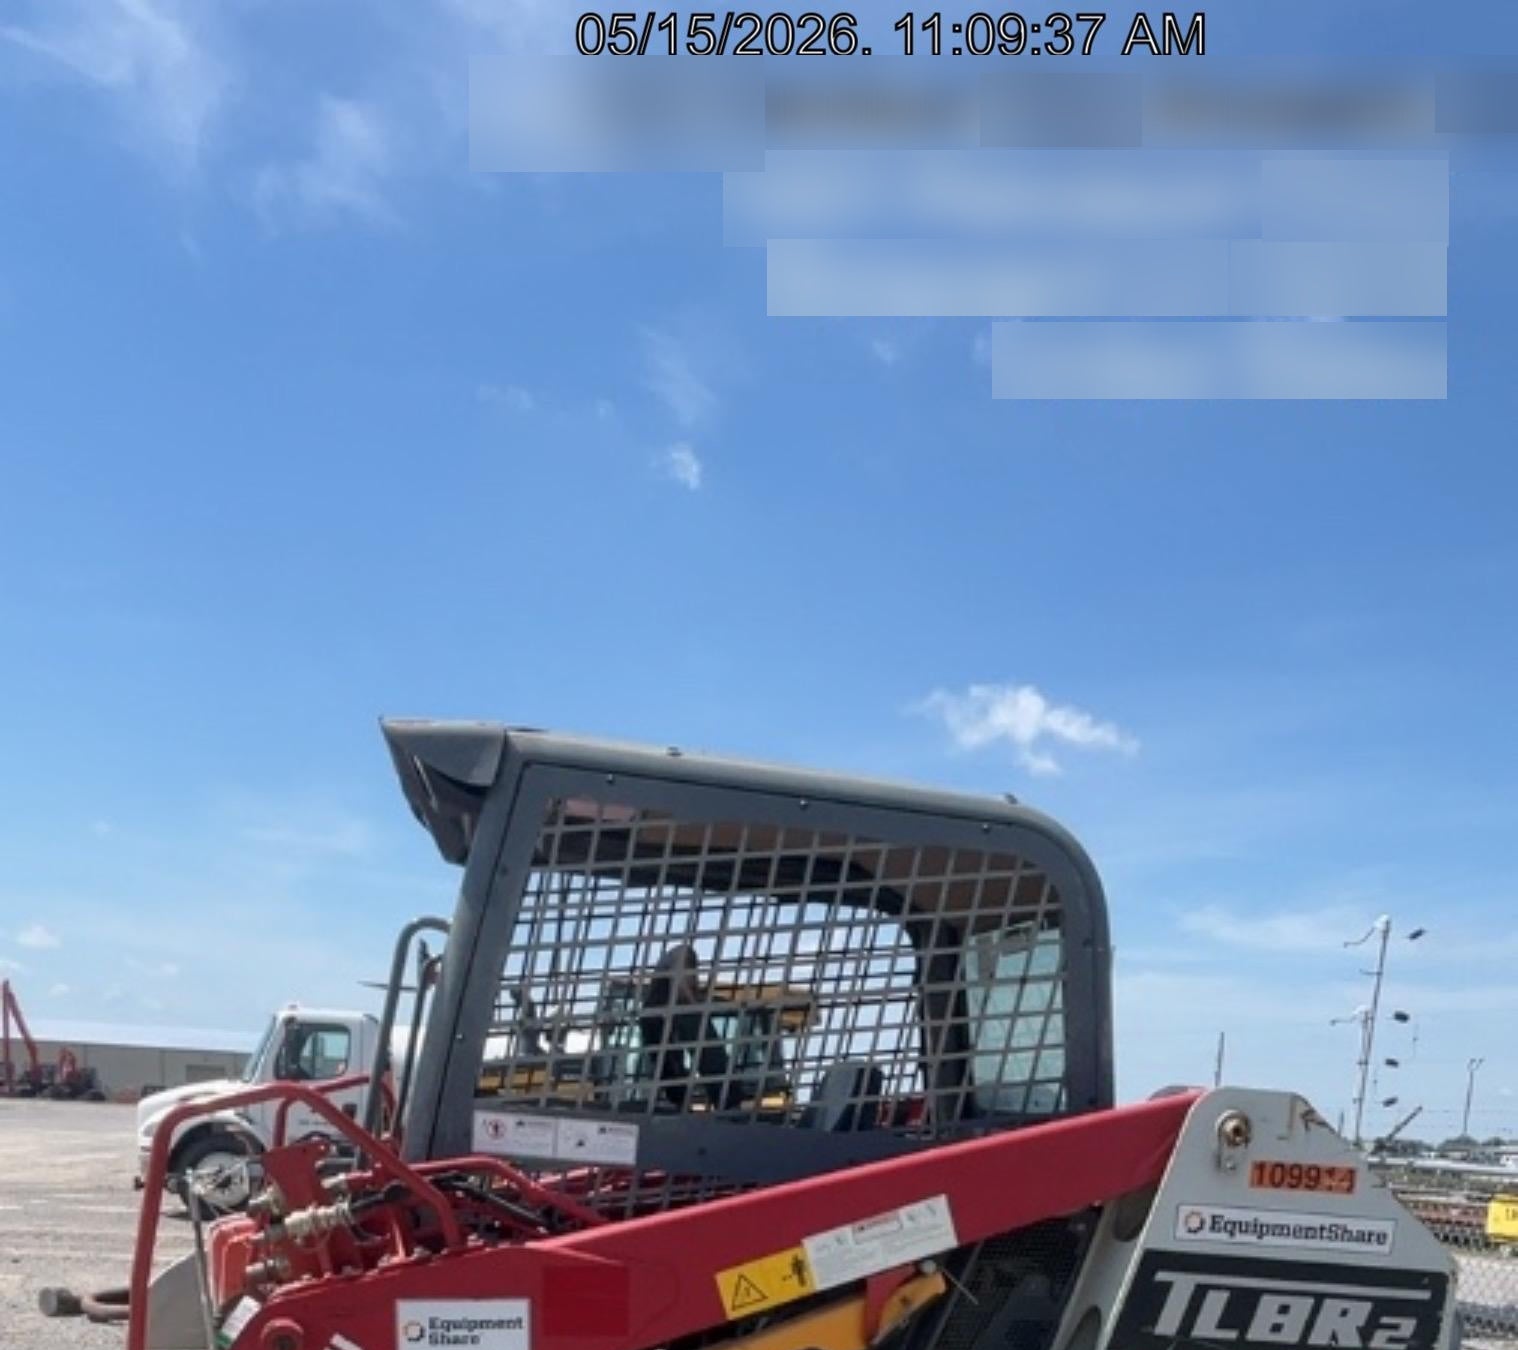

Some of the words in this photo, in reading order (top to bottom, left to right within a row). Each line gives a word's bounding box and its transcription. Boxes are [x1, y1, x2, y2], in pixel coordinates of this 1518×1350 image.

[1208, 1213, 1389, 1246] EquipmentShare
[1152, 1270, 1433, 1350] TL8R2
[428, 1316, 524, 1333] Equipment
[428, 1332, 481, 1346] Share
